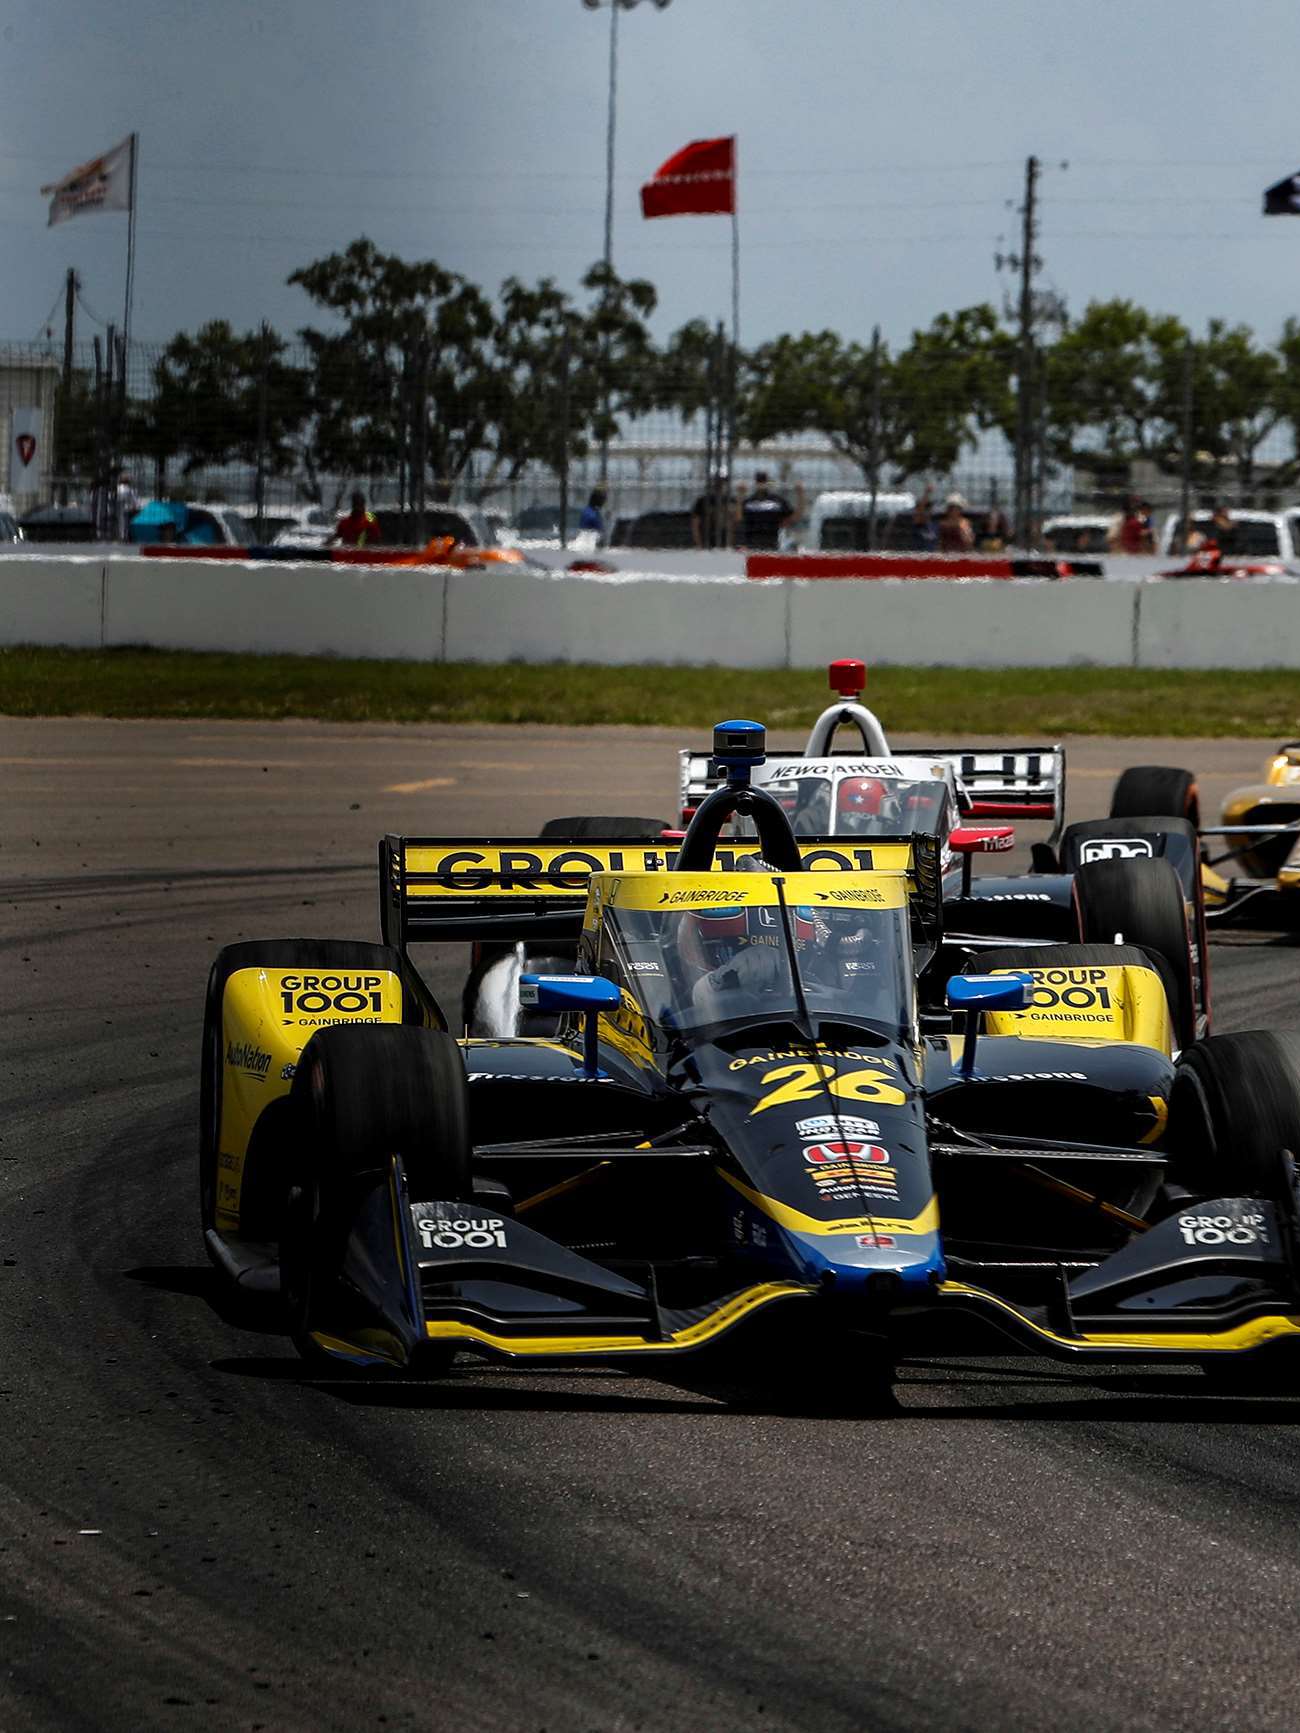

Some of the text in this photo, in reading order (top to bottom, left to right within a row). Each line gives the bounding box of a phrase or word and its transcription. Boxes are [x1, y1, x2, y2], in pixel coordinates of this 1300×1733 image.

[769, 763, 905, 780] NEWGARDEN
[669, 891, 749, 904] GAINBRIDGE
[280, 975, 382, 991] GROUP
[1009, 970, 1106, 985] ROUP
[280, 991, 382, 1014] 1001
[1032, 987, 1111, 1010] 001
[1030, 1013, 1116, 1023] GAINBRIDGE
[751, 1063, 908, 1117] 26
[418, 1219, 504, 1232] GROUP
[420, 1230, 507, 1248] 1001
